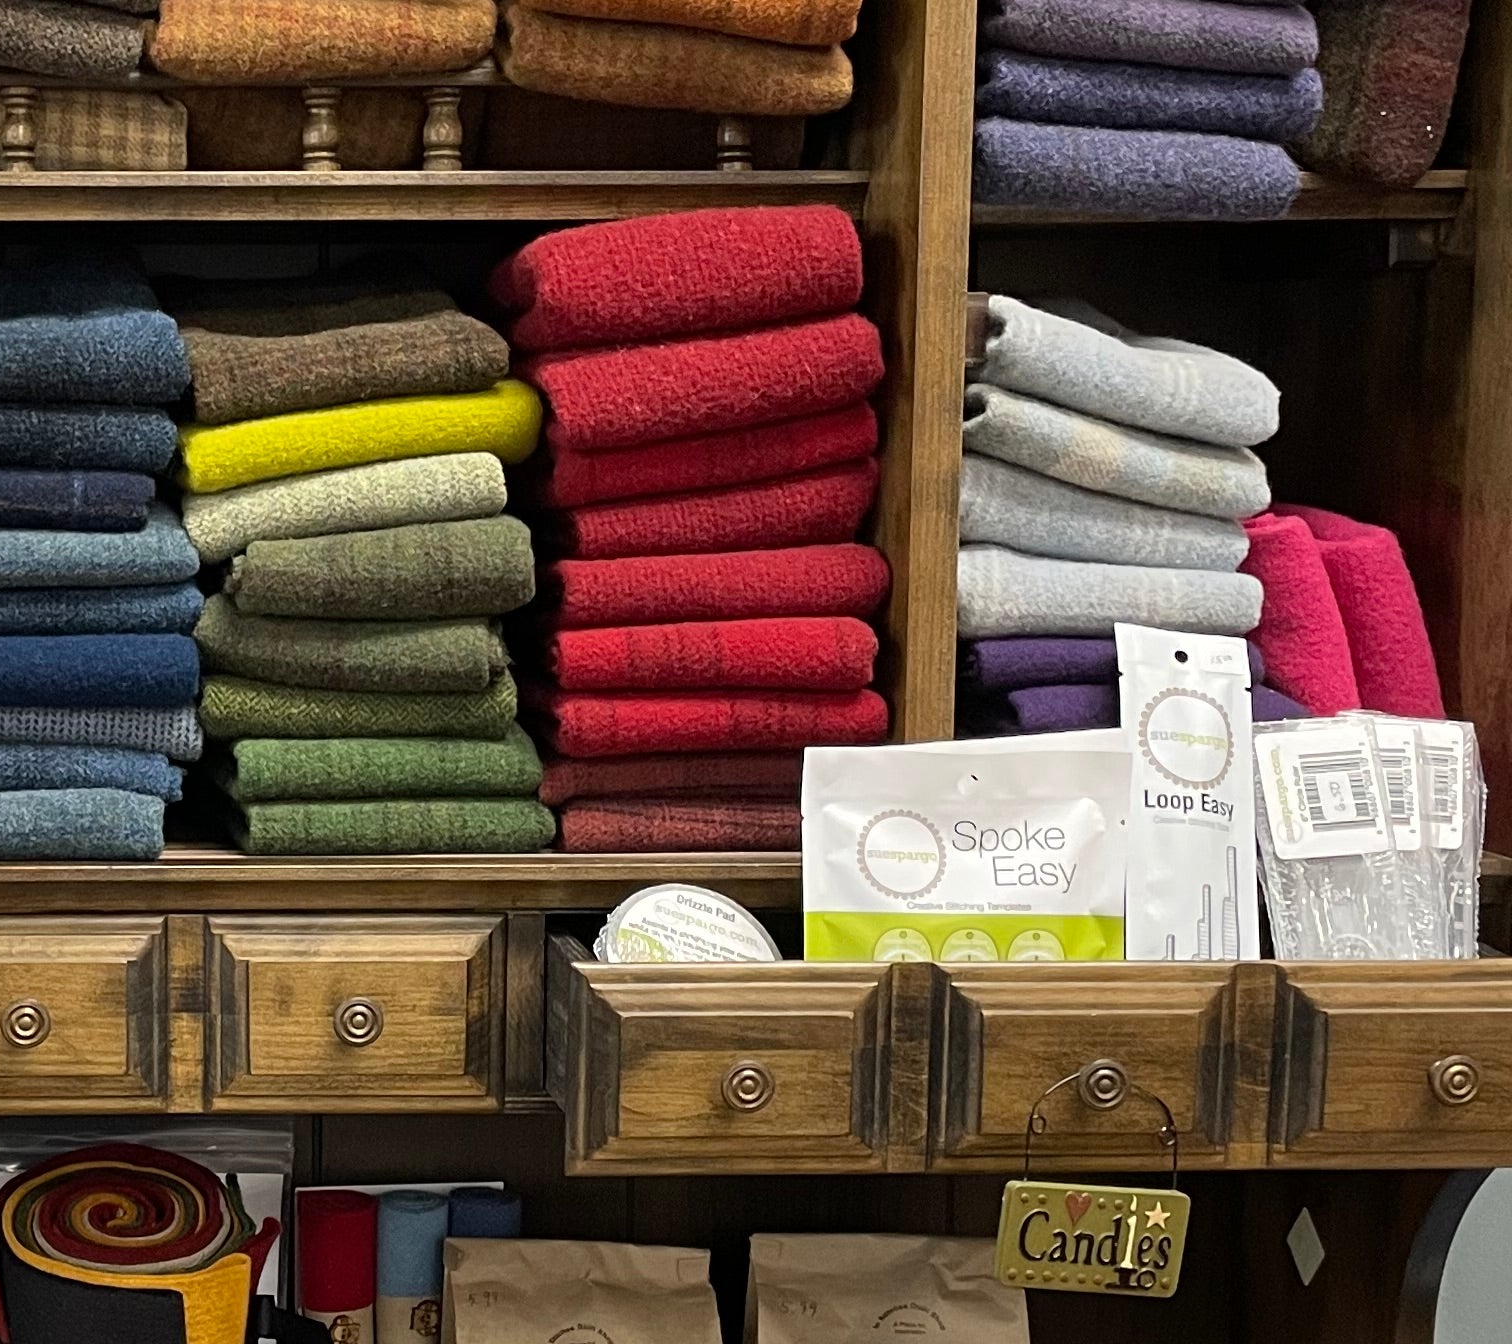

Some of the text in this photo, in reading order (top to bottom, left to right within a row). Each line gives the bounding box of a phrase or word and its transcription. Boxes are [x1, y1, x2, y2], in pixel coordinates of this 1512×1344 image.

[1144, 789, 1234, 822] Loop Easy
[951, 819, 1066, 859] Spoke
[992, 855, 1077, 894] Easy
[676, 894, 736, 923] Drizzle Pad
[1018, 1205, 1172, 1271] Candles
